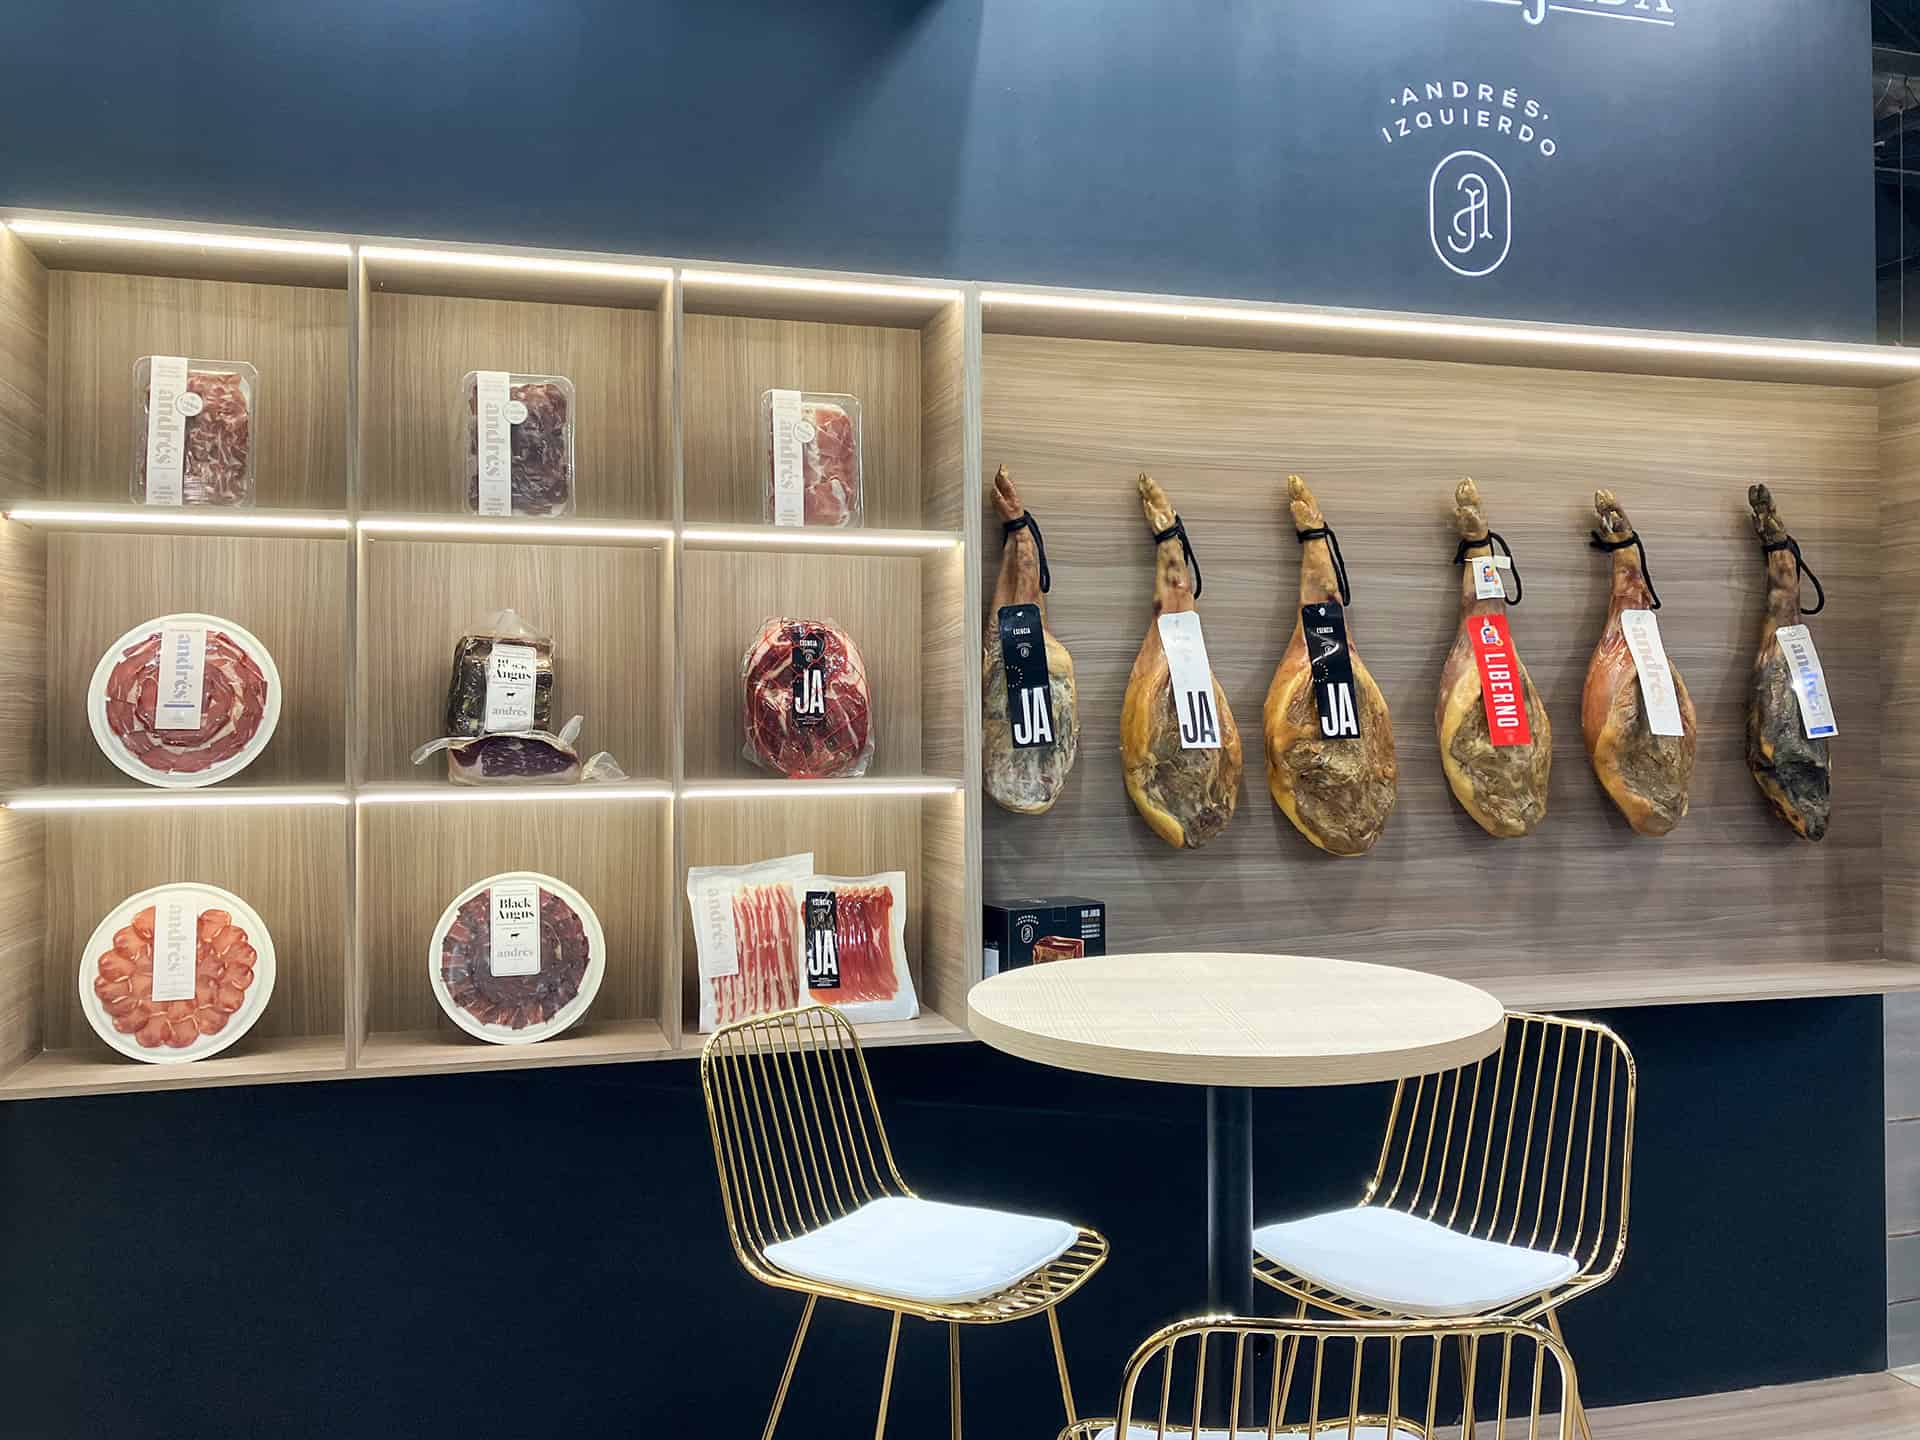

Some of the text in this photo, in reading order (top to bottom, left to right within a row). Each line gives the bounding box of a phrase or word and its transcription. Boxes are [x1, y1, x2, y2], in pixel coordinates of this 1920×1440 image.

[1382, 108, 1556, 156] IZQUIERDO
[155, 388, 180, 464] andrés
[173, 633, 195, 700] andrés
[794, 668, 825, 715] JA
[1484, 653, 1520, 728] LIBERNO
[1013, 687, 1053, 745] JA
[1181, 691, 1217, 744] JA
[1321, 682, 1359, 737] JA
[496, 910, 535, 922] Angus
[497, 897, 531, 908] Black
[806, 929, 839, 976] JA
